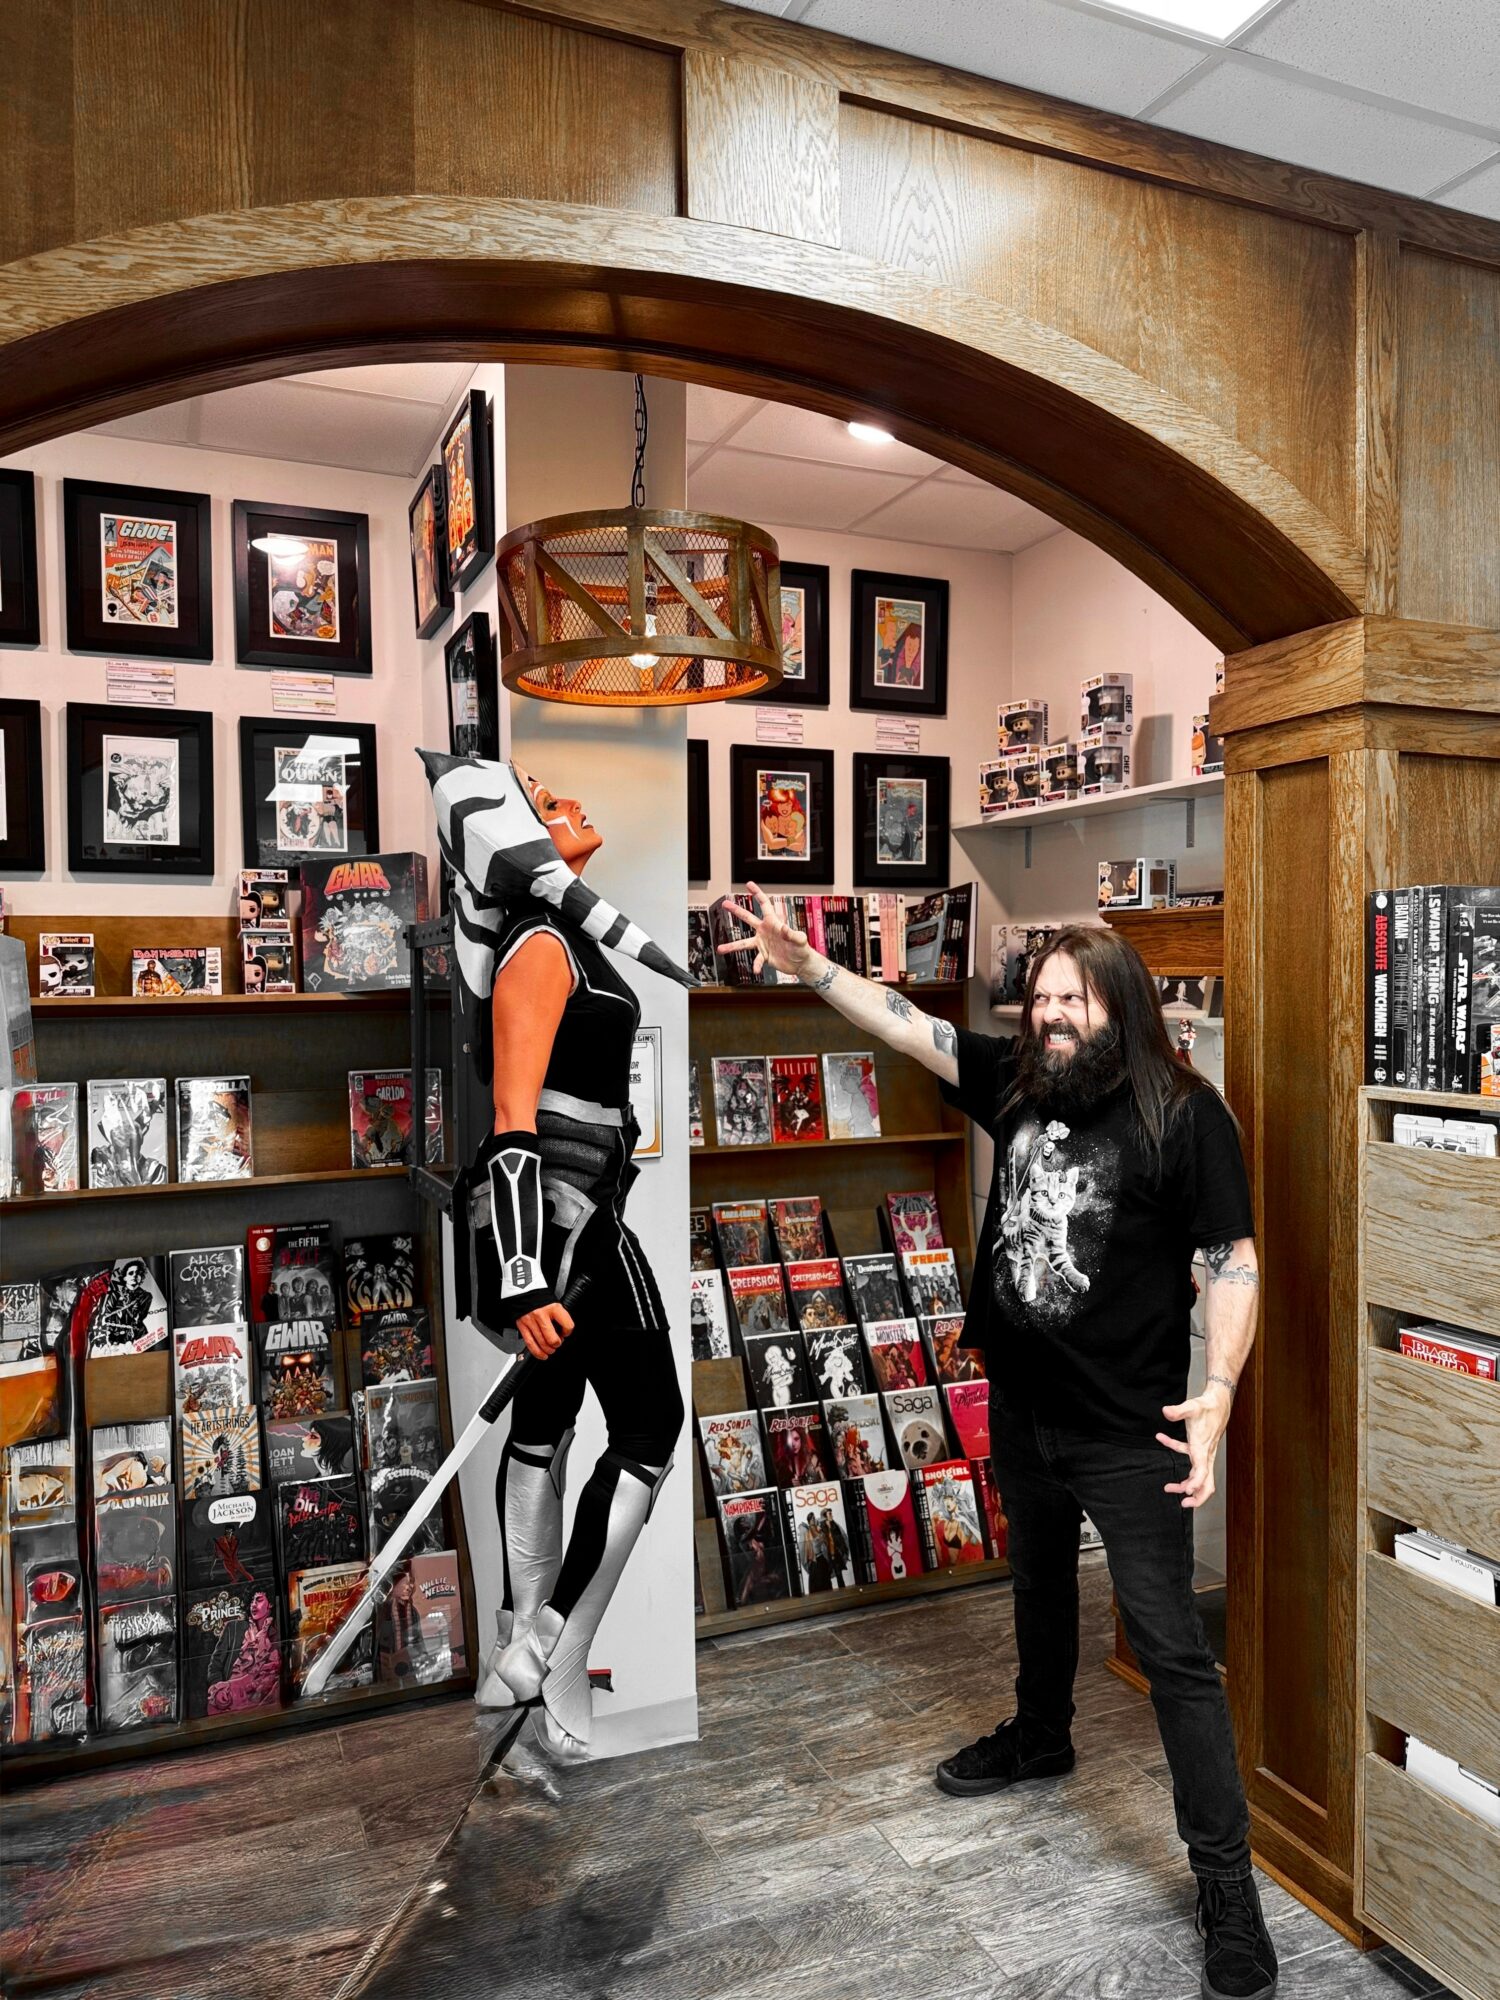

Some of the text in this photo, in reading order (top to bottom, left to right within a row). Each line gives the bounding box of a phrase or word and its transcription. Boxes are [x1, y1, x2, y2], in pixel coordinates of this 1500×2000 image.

[1125, 694, 1133, 714] CHEF
[324, 861, 391, 895] GWAR
[1175, 896, 1215, 908] ASTER
[1395, 904, 1409, 939] BATMAN
[1429, 898, 1441, 952] SWAMP
[1374, 914, 1388, 1037] ABSOLUTE WATCHMEN
[1428, 955, 1440, 1005] THING
[1455, 952, 1469, 1055] STAR WARS
[776, 1062, 818, 1075] LILITH
[299, 1236, 319, 1247] FIFTH
[189, 1252, 226, 1266] ALICE
[179, 1265, 237, 1285] COOPER
[731, 1274, 781, 1290] CREEPSHOW
[949, 1318, 964, 1331] SON
[265, 1320, 329, 1351] GWAR
[178, 1336, 243, 1366] GWAR
[1412, 1339, 1458, 1362] BLACK
[893, 1395, 933, 1414] Saga
[190, 1416, 250, 1435] HEARTSTRINGS
[708, 1418, 752, 1435] RED SONJA
[269, 1447, 295, 1459] JOAN
[269, 1456, 295, 1468] JETT
[217, 1502, 250, 1511] MICHAEL
[795, 1487, 838, 1508] Saga
[212, 1505, 254, 1520] JACKSON
[1450, 1555, 1484, 1575] EVOLUTION
[419, 1577, 447, 1593] WILLIE
[425, 1584, 456, 1600] NELSON
[201, 1605, 241, 1621] PRINCE
